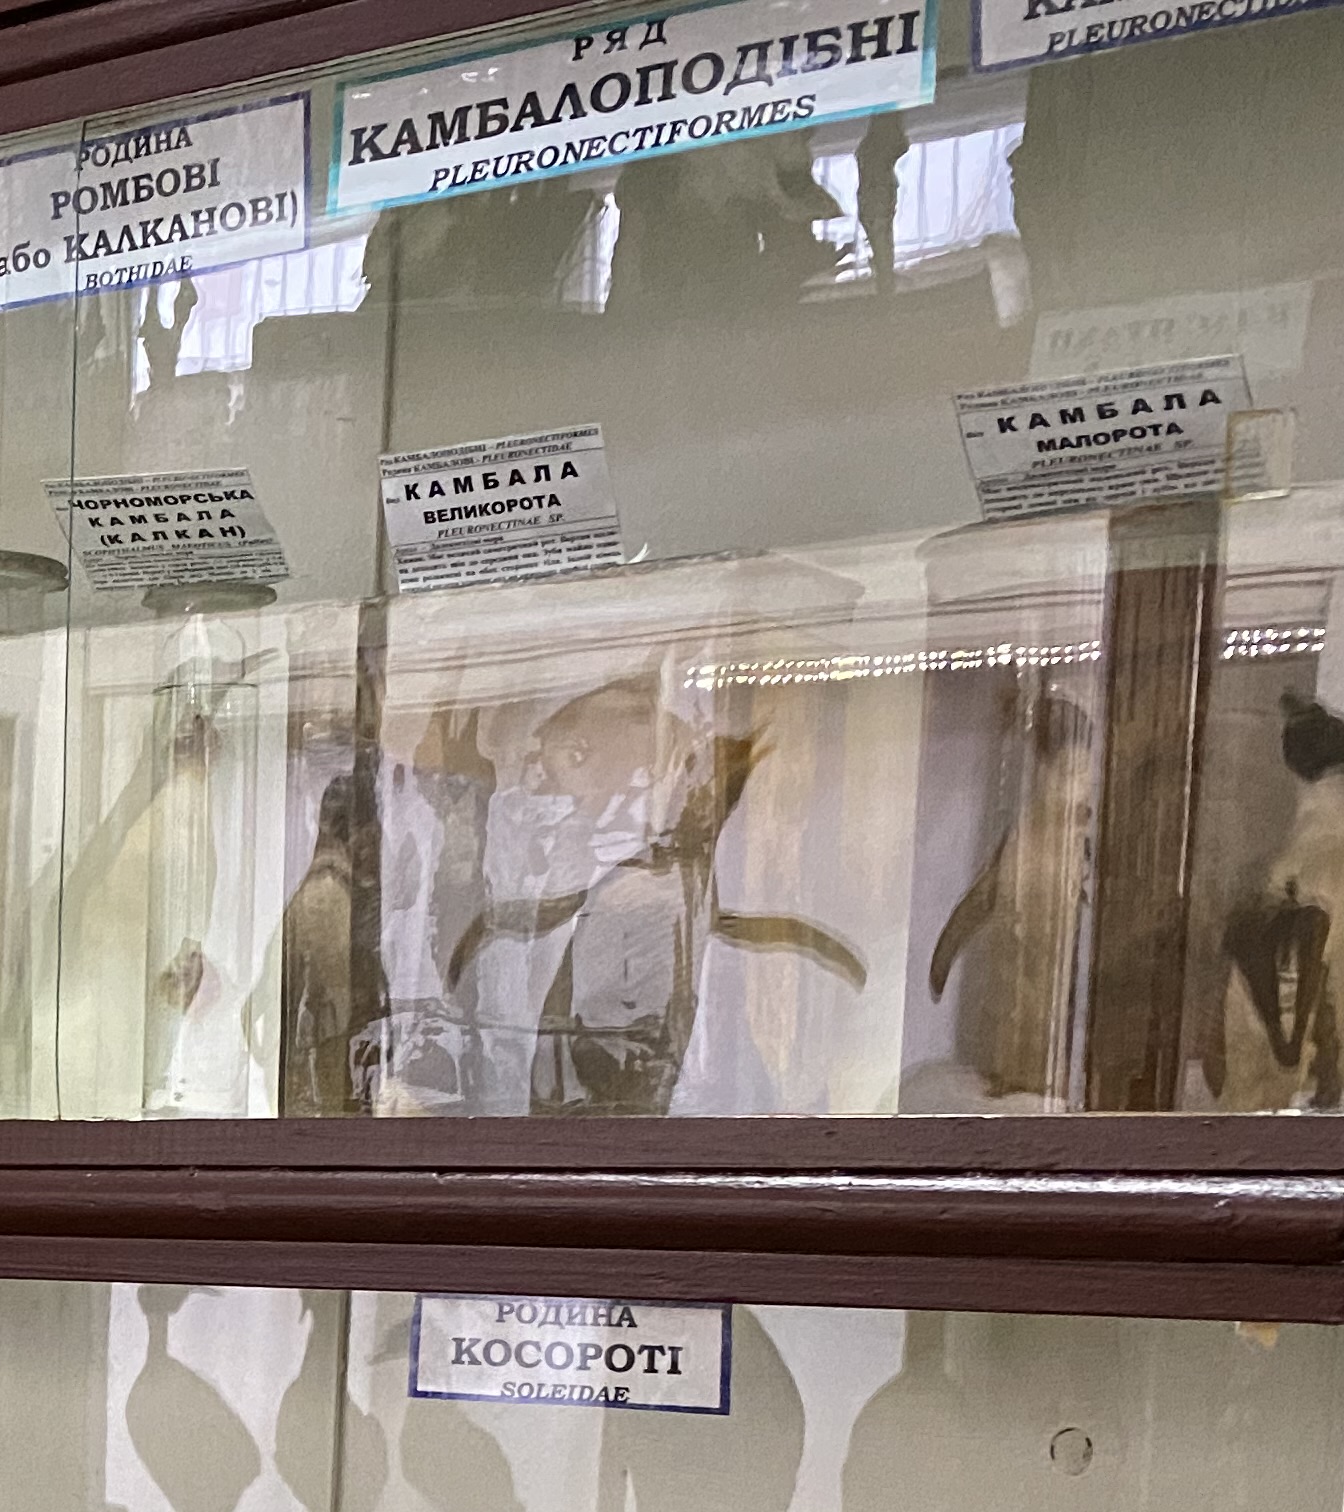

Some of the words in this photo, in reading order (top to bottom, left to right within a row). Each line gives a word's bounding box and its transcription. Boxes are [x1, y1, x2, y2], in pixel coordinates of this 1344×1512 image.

[572, 17, 670, 61] РЯД
[348, 10, 921, 166] КАМБАЛОПОДІБНІ
[74, 126, 193, 171] РОДИНА
[428, 95, 817, 192] PLEURONECTIFORMES
[50, 158, 221, 221] РОМБОВІ
[64, 191, 298, 263] КАЛКАНОВІ)
[85, 256, 193, 291] BOTHIDAE
[997, 389, 1222, 433] КАМБАЛА
[1037, 422, 1183, 453] МАЛОРОТА
[405, 461, 579, 500] КАМБАЛА
[68, 489, 255, 511] ЧОРНОМОРСЬКА
[88, 508, 236, 528] КАМБАЛА
[424, 494, 562, 524] ВЕЛИКОРОТА
[100, 525, 246, 547] (КАЛКАН)
[495, 1302, 638, 1328] РОДИНА
[451, 1337, 683, 1375] КОСОРОТІ
[500, 1382, 631, 1403] SOLEIDAE
